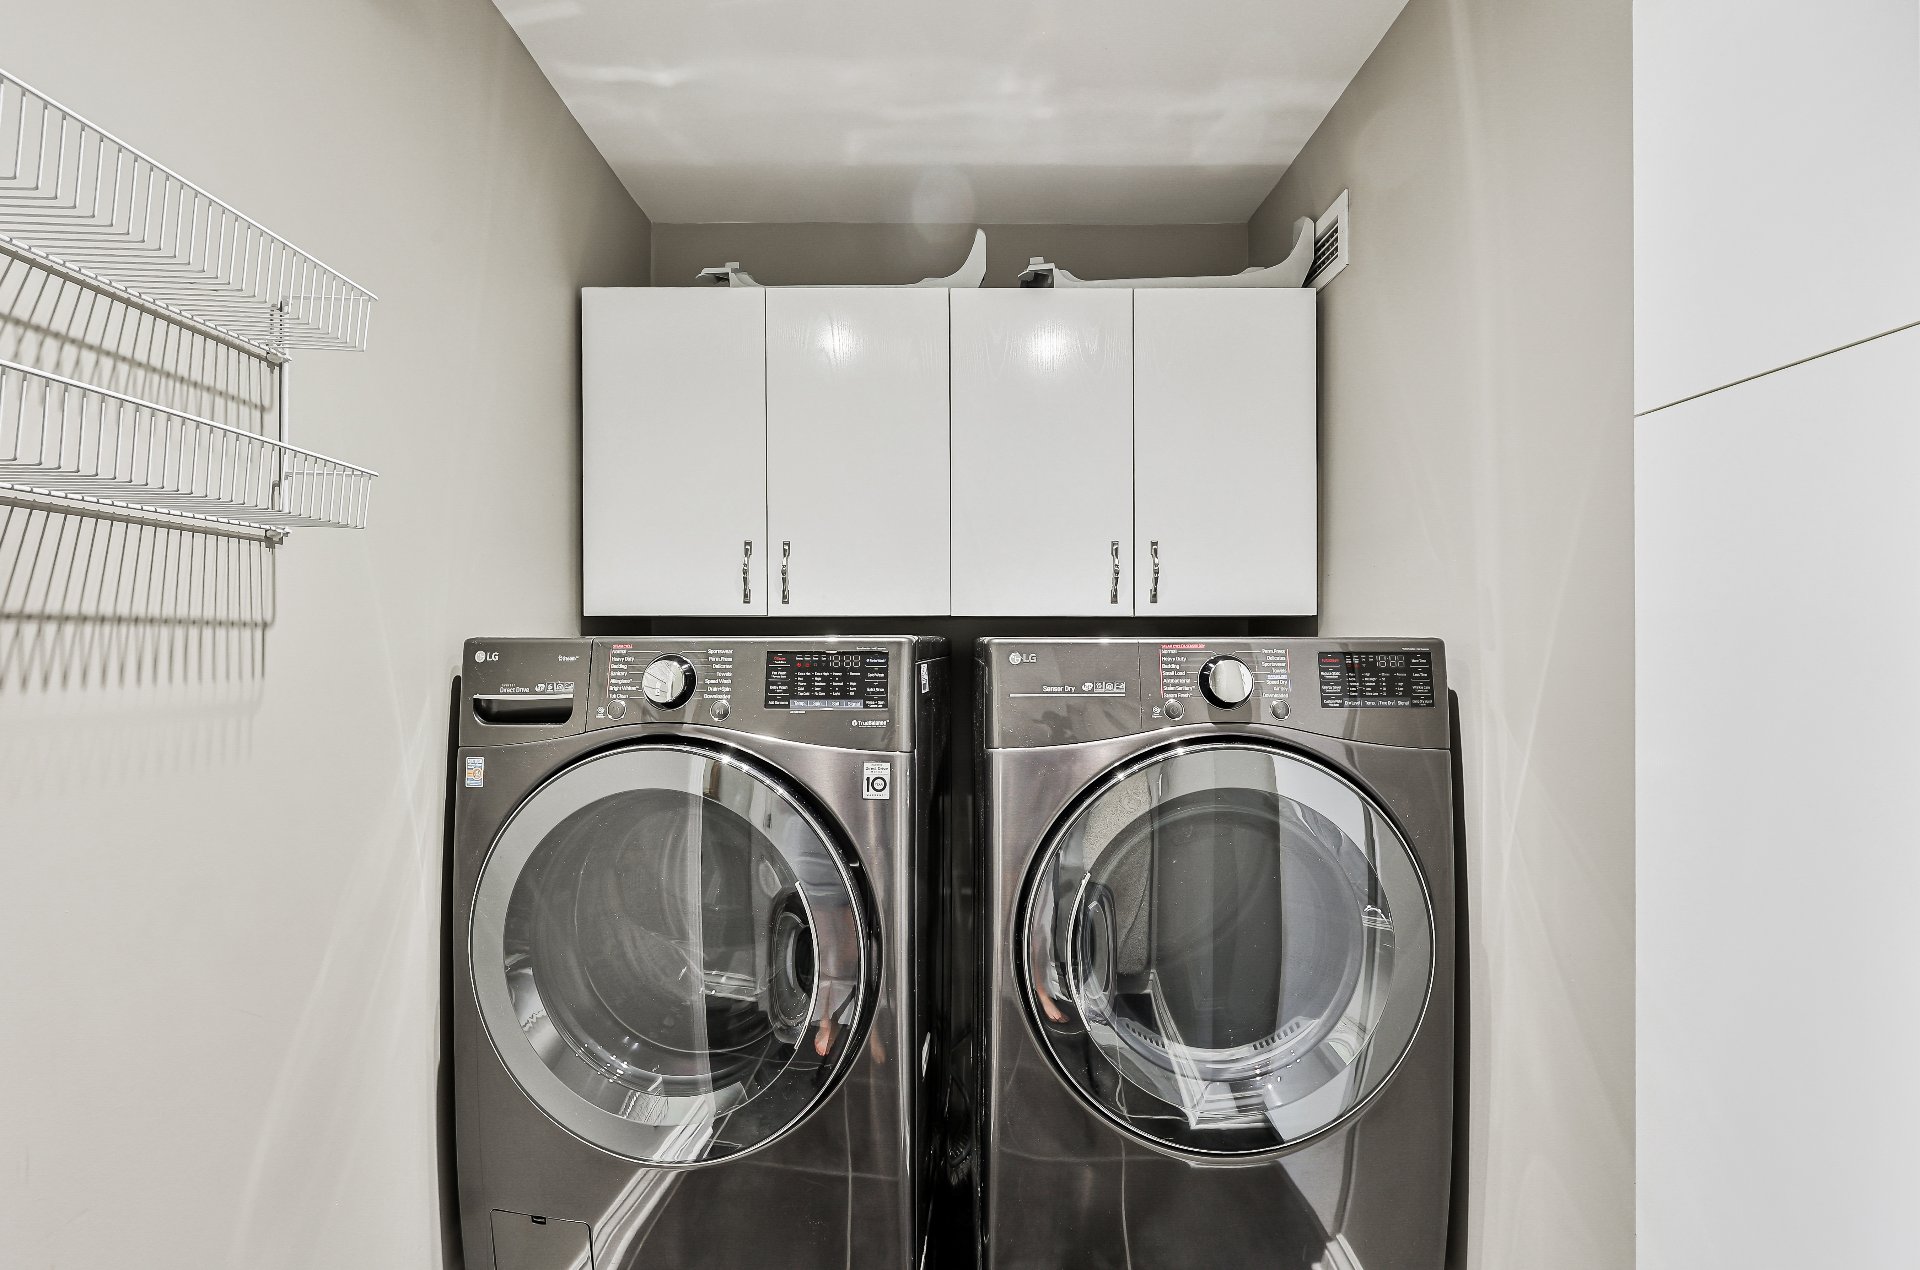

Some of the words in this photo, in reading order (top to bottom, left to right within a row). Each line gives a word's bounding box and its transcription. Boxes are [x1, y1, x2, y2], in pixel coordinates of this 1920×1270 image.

[486, 652, 499, 661] LG
[1023, 654, 1037, 663] LG
[866, 776, 887, 792] 10
